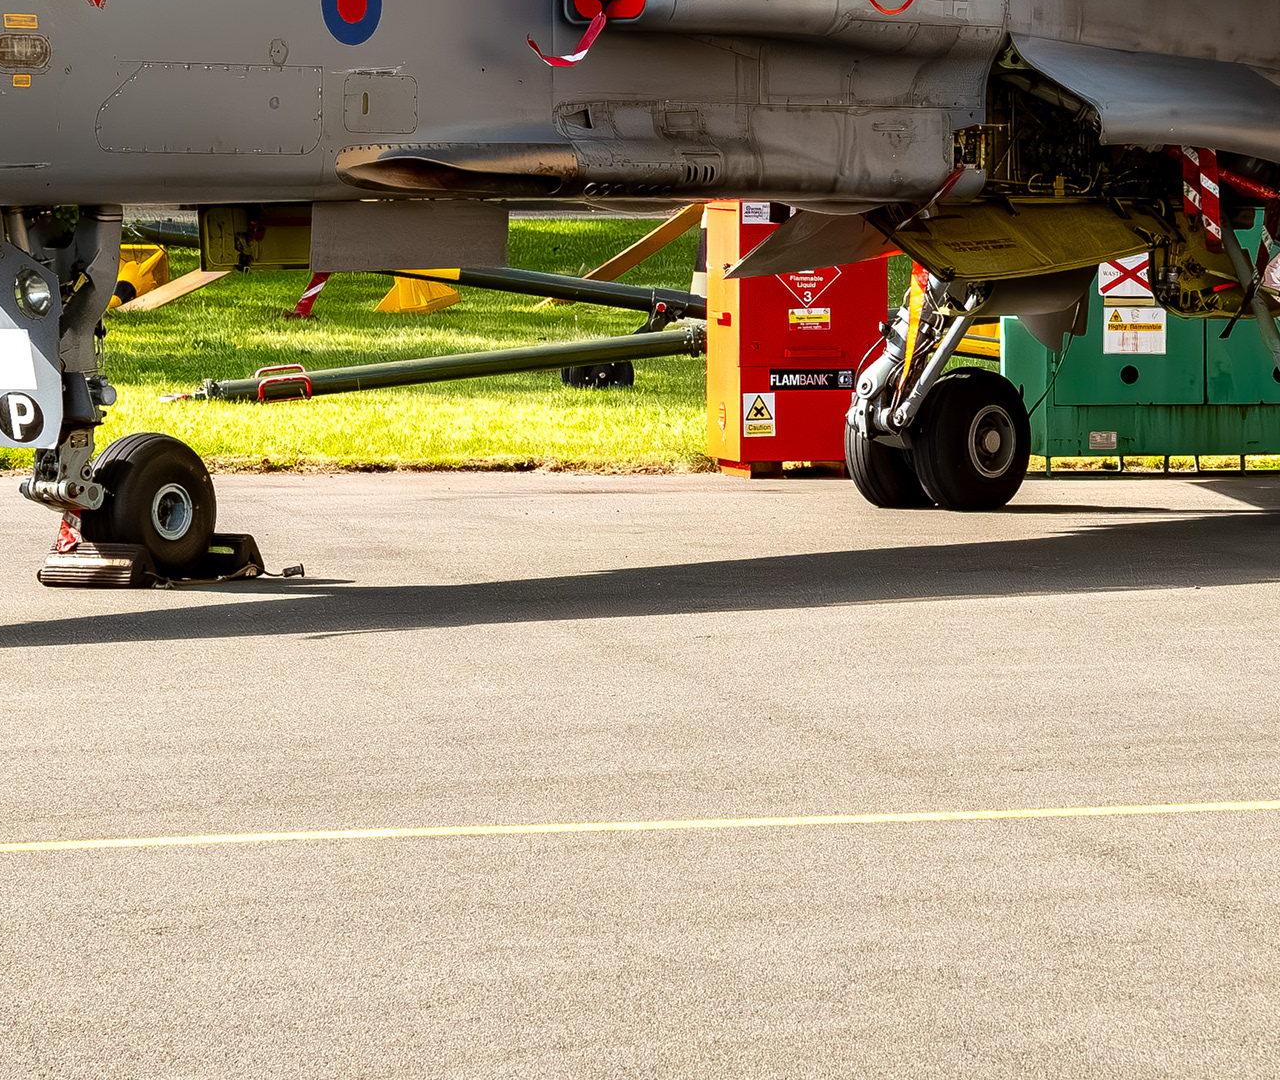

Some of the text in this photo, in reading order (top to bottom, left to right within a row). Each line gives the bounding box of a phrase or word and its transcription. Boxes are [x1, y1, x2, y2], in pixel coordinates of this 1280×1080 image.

[803, 291, 812, 302] 3
[8, 396, 35, 440] P
[748, 424, 772, 432] Caution
